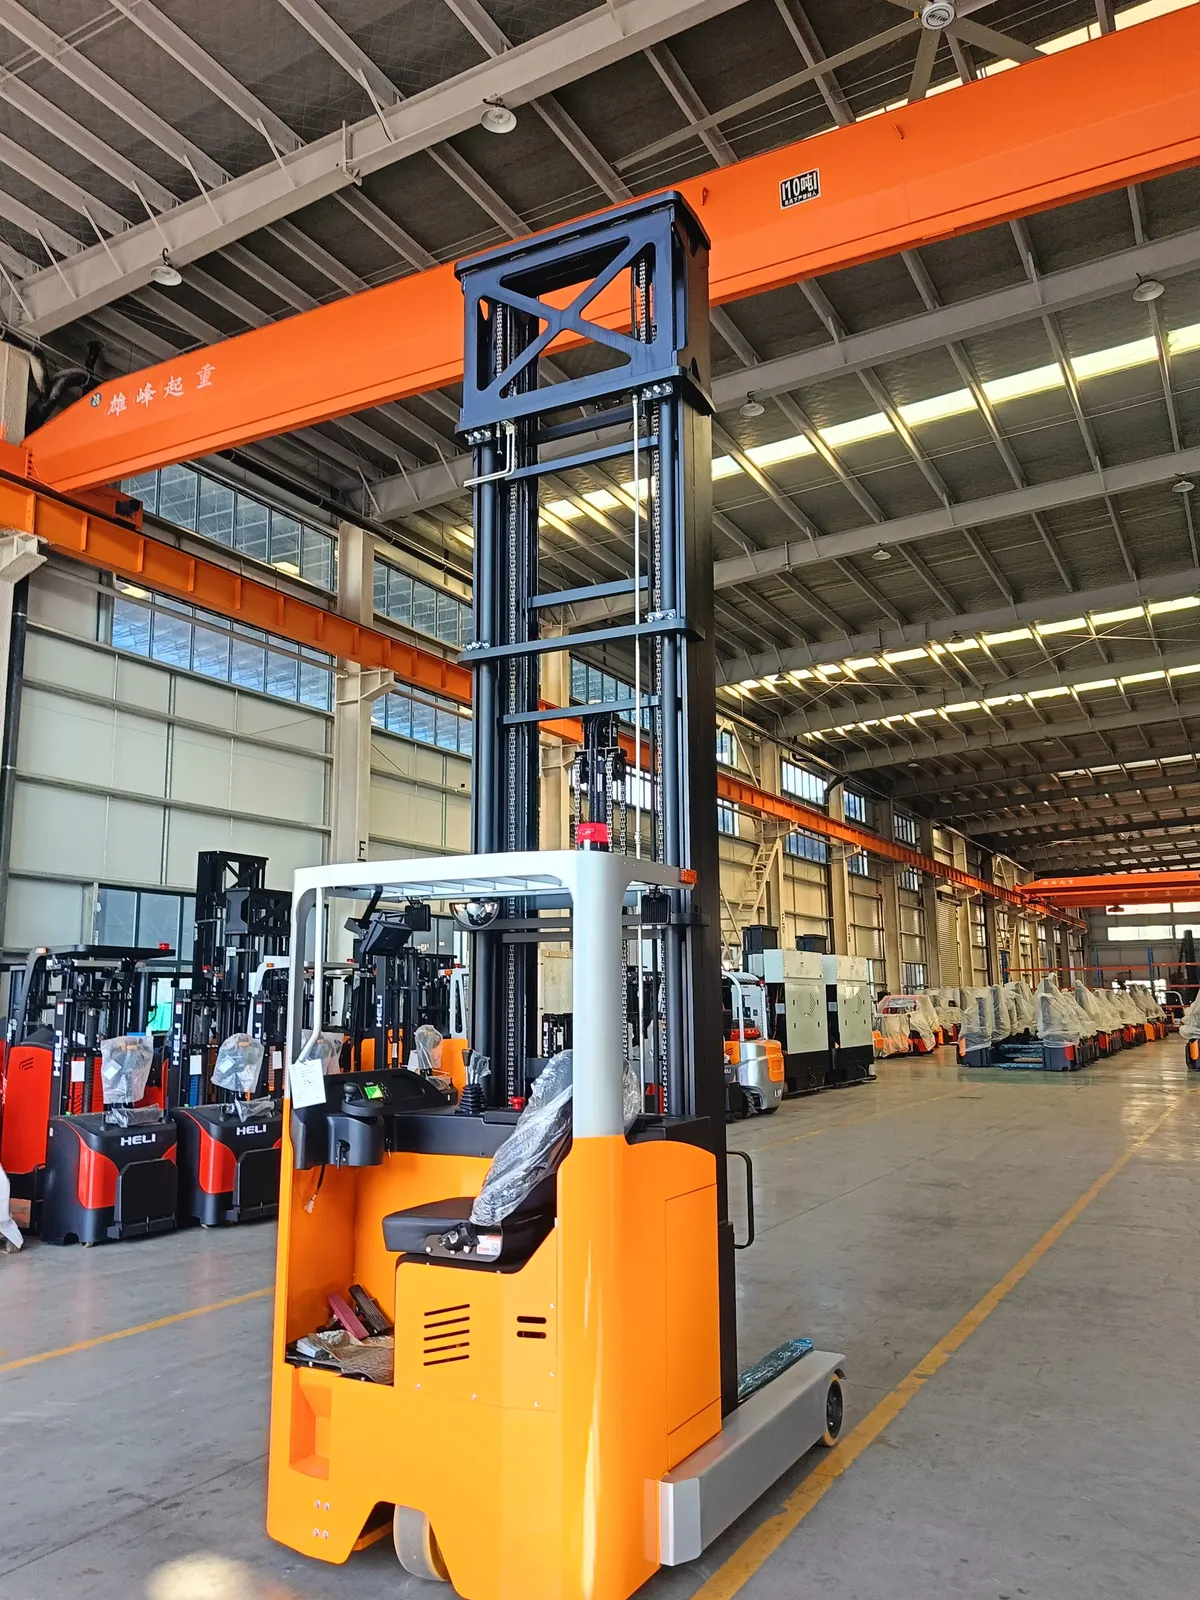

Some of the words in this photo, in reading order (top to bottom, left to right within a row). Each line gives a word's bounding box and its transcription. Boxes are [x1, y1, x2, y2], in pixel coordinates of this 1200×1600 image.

[106, 363, 216, 416] 雄峰起重
[53, 1029, 63, 1077] HELI
[172, 1022, 182, 1066] HELI
[120, 1133, 156, 1147] HELI
[236, 1124, 267, 1136] HELI
